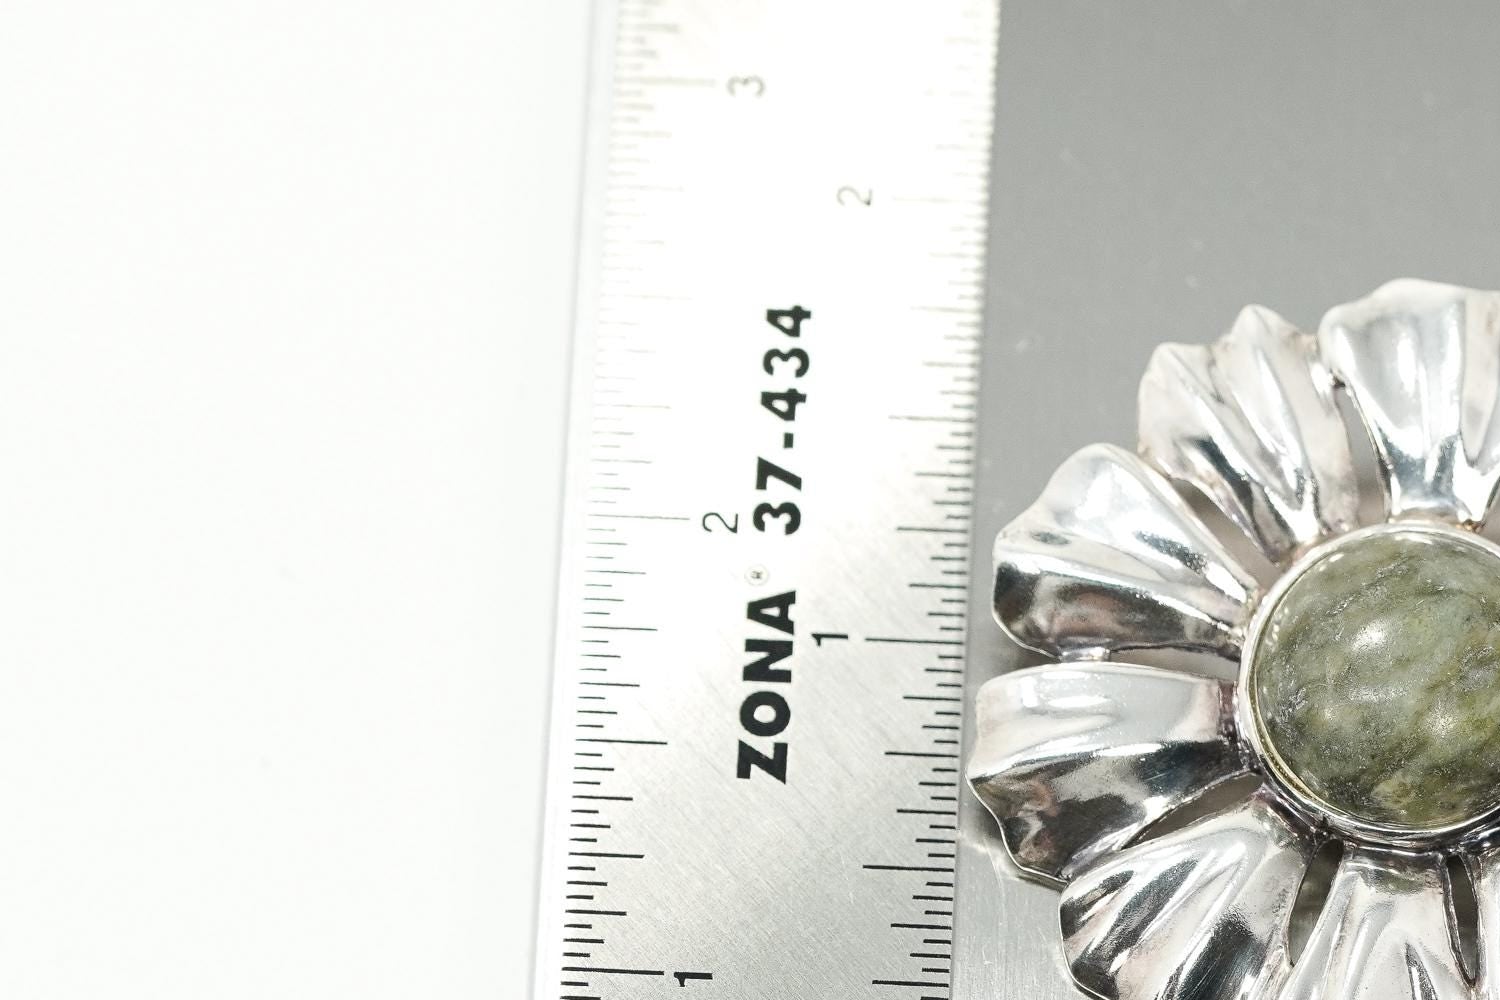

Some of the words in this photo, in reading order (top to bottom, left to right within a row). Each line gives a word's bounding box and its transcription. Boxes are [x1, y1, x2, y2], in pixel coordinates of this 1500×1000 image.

[726, 73, 767, 98] 3
[835, 184, 874, 208] 2
[752, 303, 813, 537] 37-434
[700, 511, 740, 535] 2
[810, 631, 850, 649] 1
[735, 589, 798, 787] ZONA
[673, 971, 714, 988] 1
